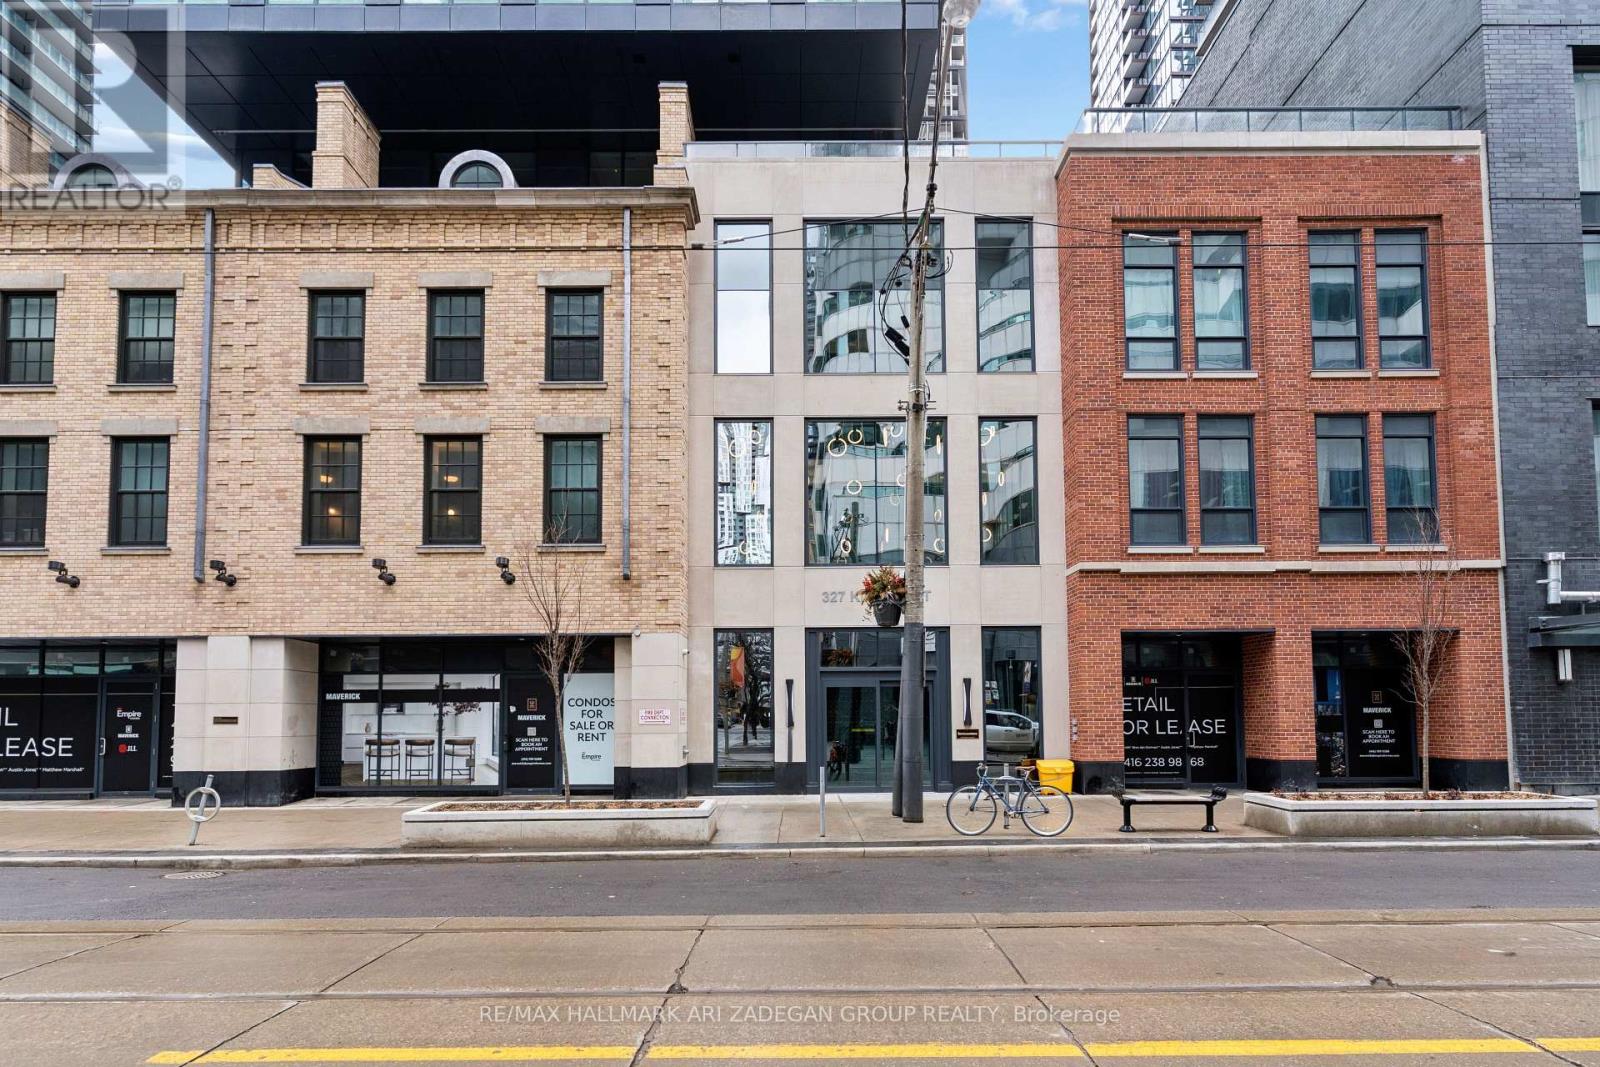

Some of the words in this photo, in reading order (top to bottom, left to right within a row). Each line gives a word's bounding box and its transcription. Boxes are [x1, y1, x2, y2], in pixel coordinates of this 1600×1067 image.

[822, 591, 846, 603] 327
[568, 698, 615, 707] CONDOS
[1122, 697, 1176, 712] ETAIL
[116, 708, 142, 719] Empire
[581, 709, 603, 719] FOR
[569, 720, 596, 731] SALE
[597, 720, 615, 731] OR
[1123, 719, 1150, 735] OR
[577, 732, 607, 742] RENT
[581, 751, 602, 760] Empire
[1124, 757, 1143, 767] 416
[1144, 757, 1166, 767] 238
